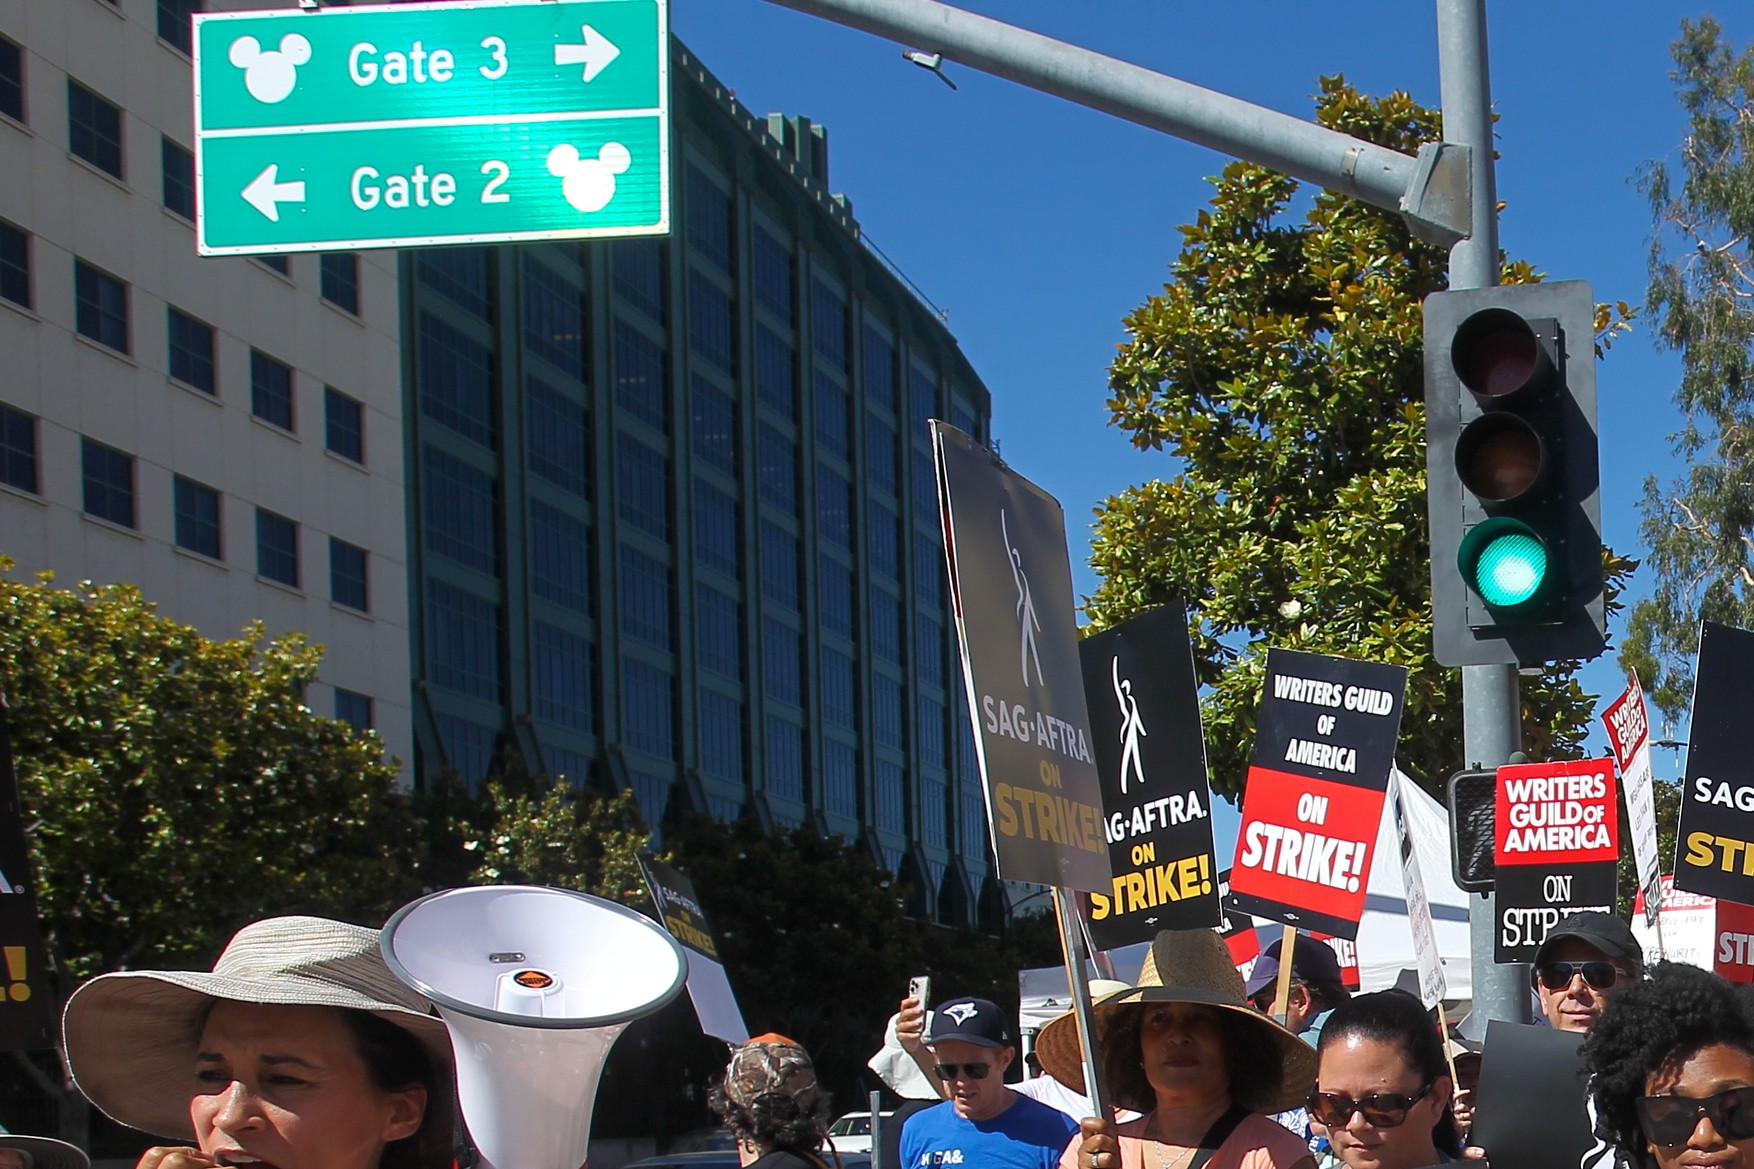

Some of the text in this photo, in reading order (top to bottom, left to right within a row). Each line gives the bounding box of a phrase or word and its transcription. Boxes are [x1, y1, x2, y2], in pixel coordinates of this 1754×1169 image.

[348, 36, 509, 87] Gate 3
[351, 160, 511, 211] Gate 2
[1274, 674, 1393, 716] WRITERS GUILD
[1317, 715, 1336, 737] OF
[1284, 738, 1356, 775] AMERICA
[1039, 759, 1062, 790] ON
[1505, 773, 1606, 803] WRITERS
[995, 782, 1106, 857] STRIKE!
[1104, 790, 1207, 844] G·AFTRA
[1297, 793, 1327, 826] ON
[1509, 801, 1605, 828] GUILD OF
[1131, 842, 1155, 866] ON
[1503, 824, 1611, 852] AMERICA
[1241, 820, 1367, 893] STRIKE!
[1090, 854, 1212, 920] STRIKE!
[1543, 875, 1573, 902] ON
